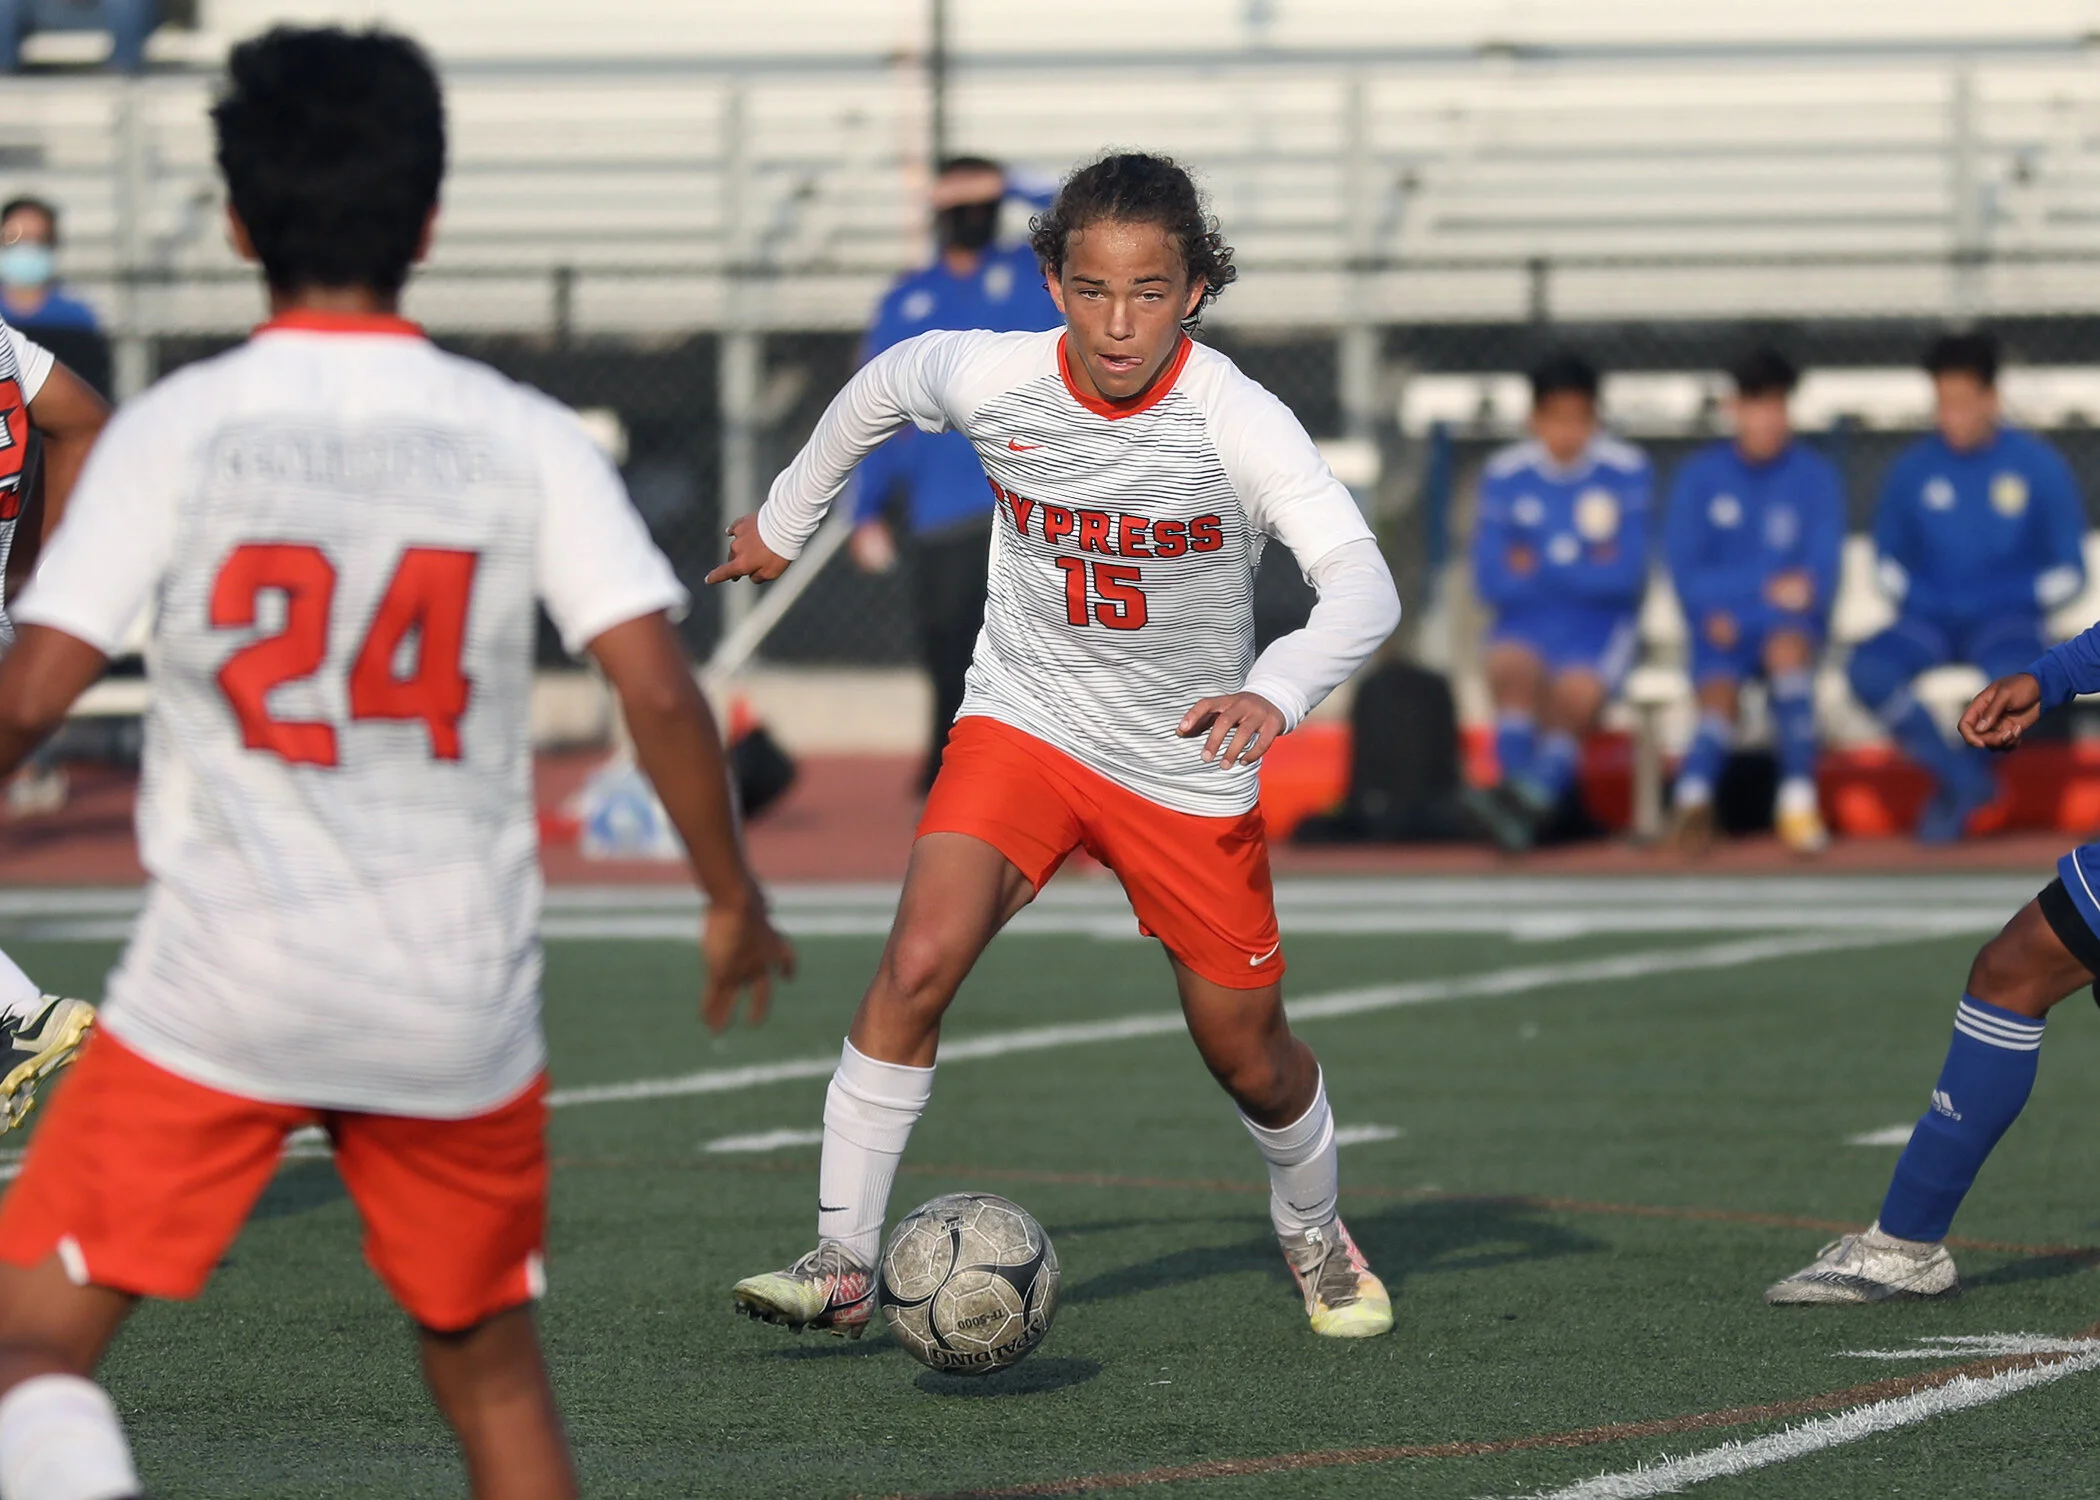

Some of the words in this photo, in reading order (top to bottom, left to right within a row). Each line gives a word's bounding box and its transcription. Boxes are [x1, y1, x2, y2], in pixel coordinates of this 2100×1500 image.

[1055, 556, 1148, 631] 15
[208, 541, 481, 769] 24
[931, 1318, 1042, 1367] SPALDING
[957, 1308, 1005, 1330] TF-5000
